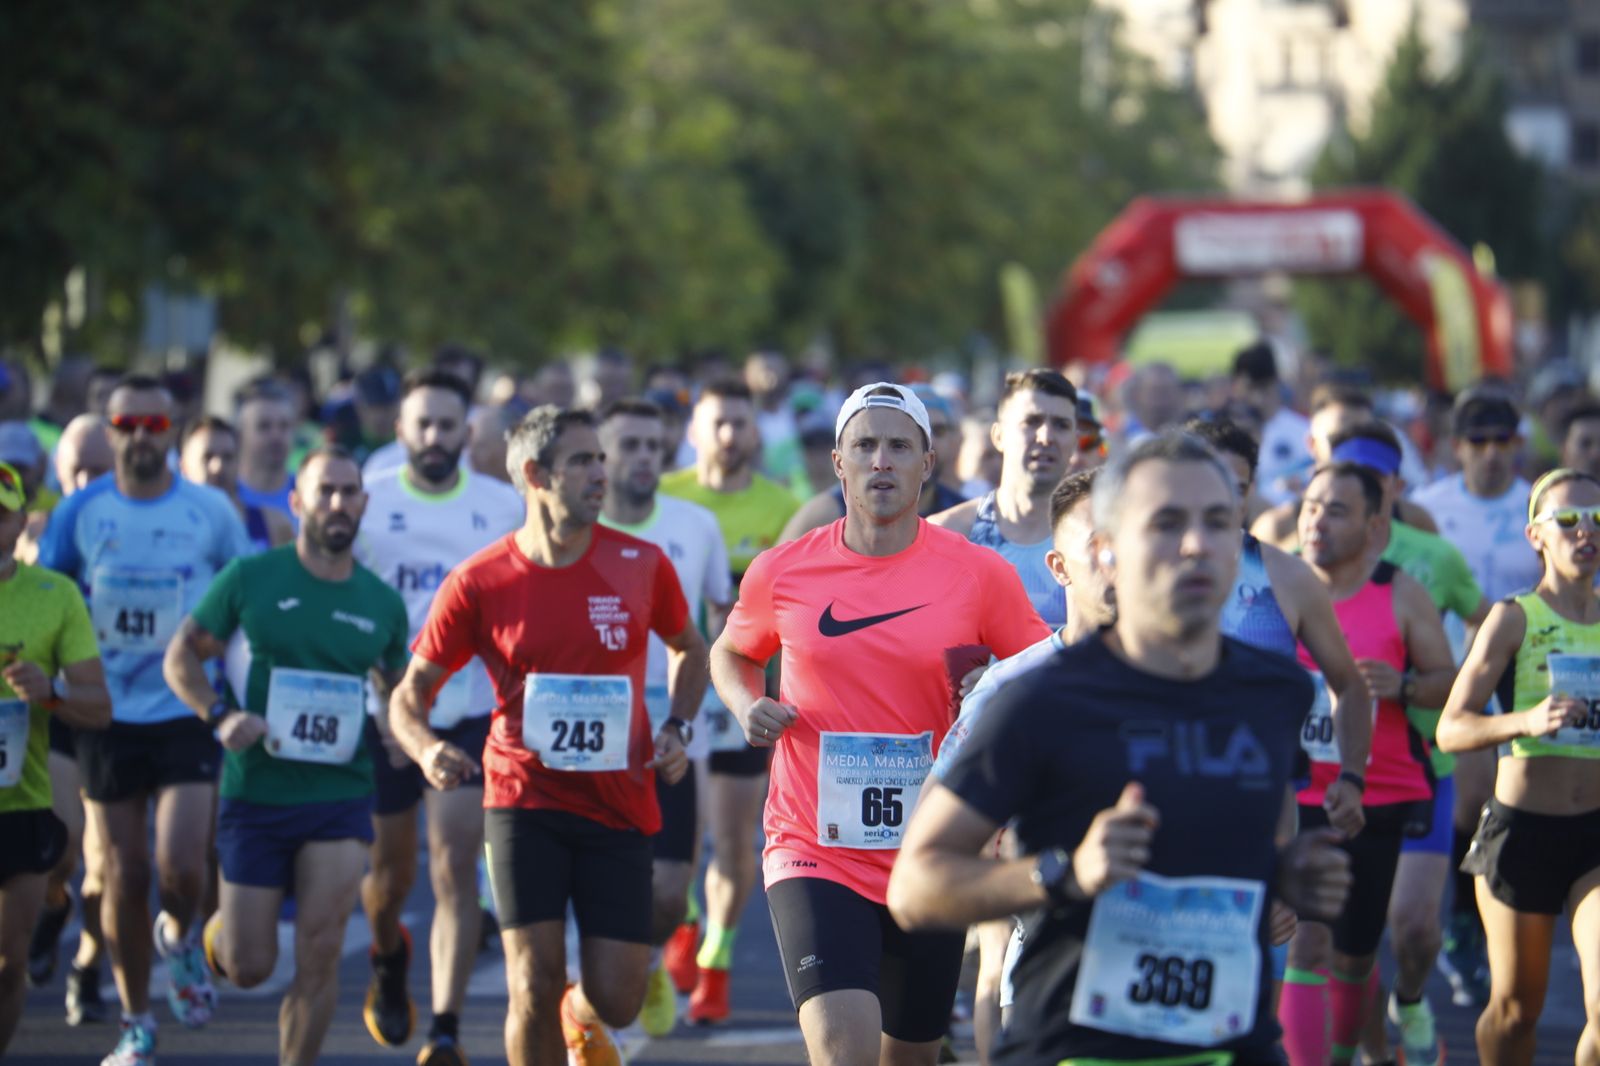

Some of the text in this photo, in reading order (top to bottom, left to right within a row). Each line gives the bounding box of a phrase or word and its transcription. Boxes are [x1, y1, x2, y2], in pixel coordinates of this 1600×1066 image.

[398, 562, 450, 591] hd
[115, 607, 155, 637] 431
[291, 713, 339, 745] 458
[551, 720, 605, 753] 243
[826, 754, 869, 767] MEDIA
[1120, 719, 1271, 777] FILA
[861, 786, 903, 828] 65
[791, 860, 818, 868] TEAM
[1129, 953, 1215, 1013] 369
